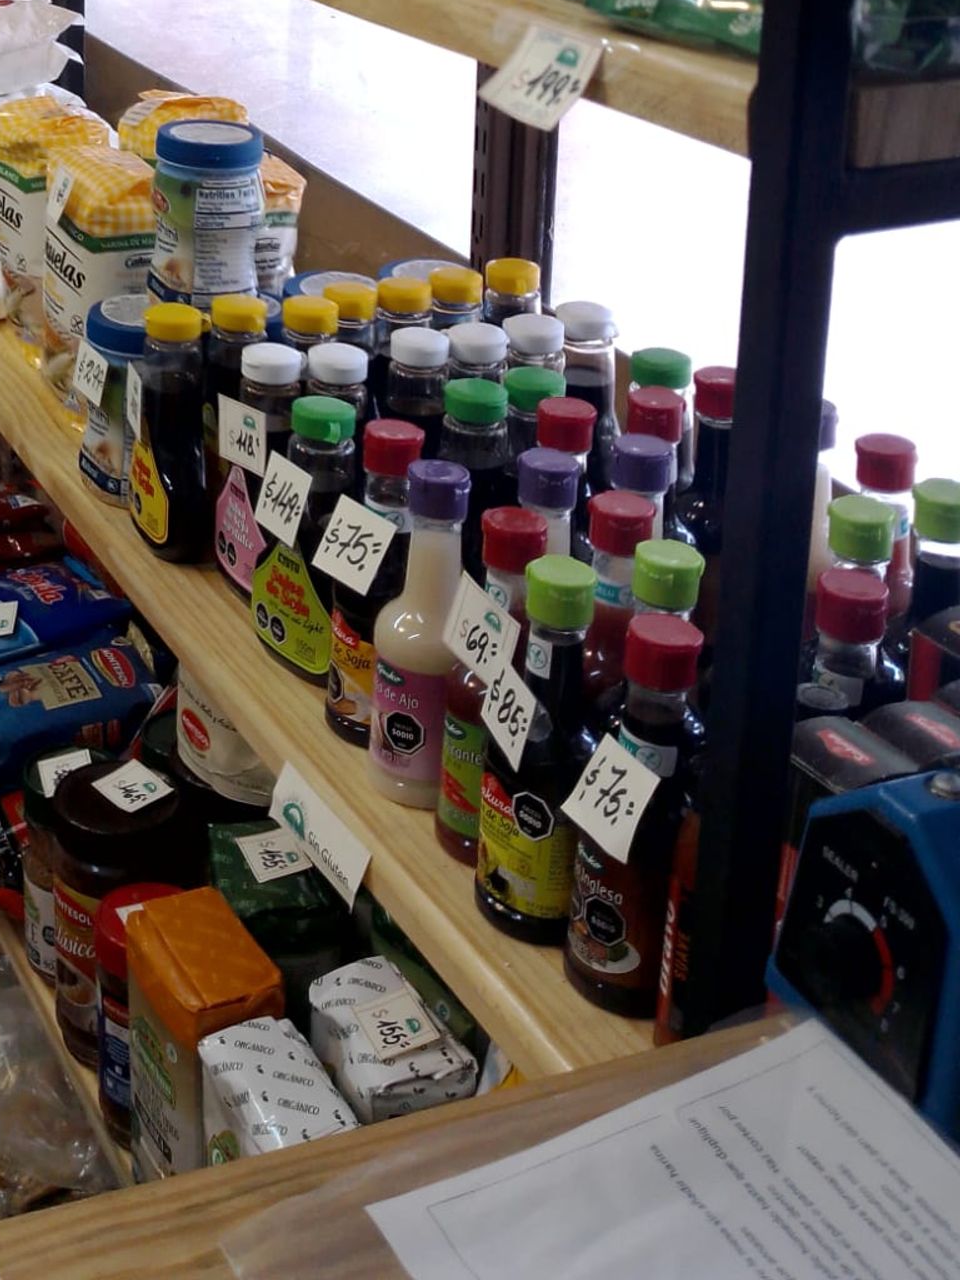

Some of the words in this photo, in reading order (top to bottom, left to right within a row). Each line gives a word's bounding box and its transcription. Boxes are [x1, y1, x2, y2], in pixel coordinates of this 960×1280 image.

[44, 236, 86, 290] uelas
[345, 647, 371, 671] Soja
[384, 688, 396, 701] de
[398, 694, 419, 709] Ajo
[391, 730, 415, 742] SODIO
[308, 831, 320, 855] Sin
[321, 848, 350, 890] Gluten
